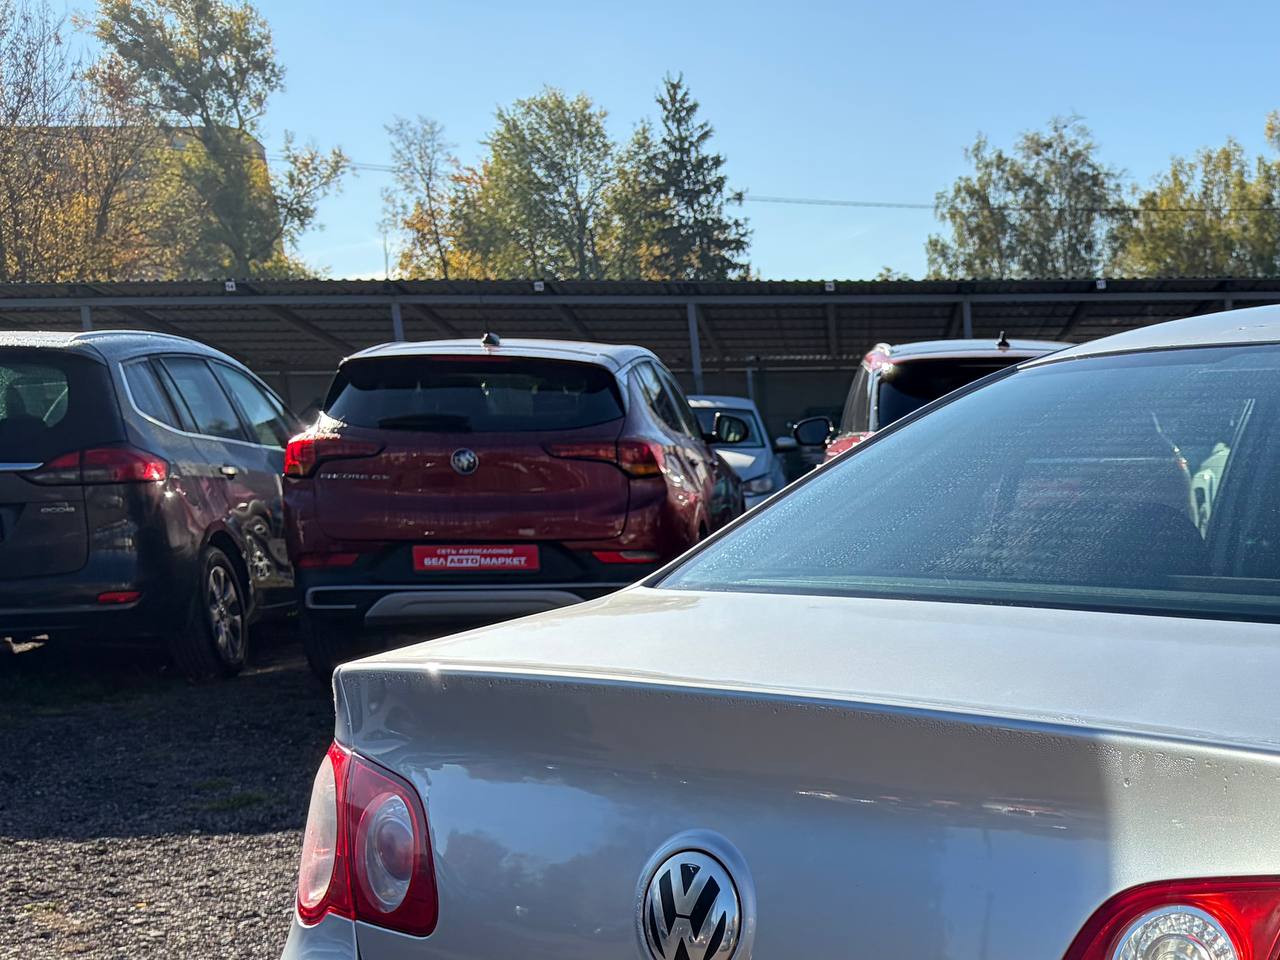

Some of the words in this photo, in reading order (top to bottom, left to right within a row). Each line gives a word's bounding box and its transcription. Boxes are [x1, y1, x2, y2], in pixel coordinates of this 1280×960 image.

[424, 557, 446, 567] БЕЛ
[448, 557, 479, 566] АВТО
[480, 557, 527, 566] МАРКЕТ
